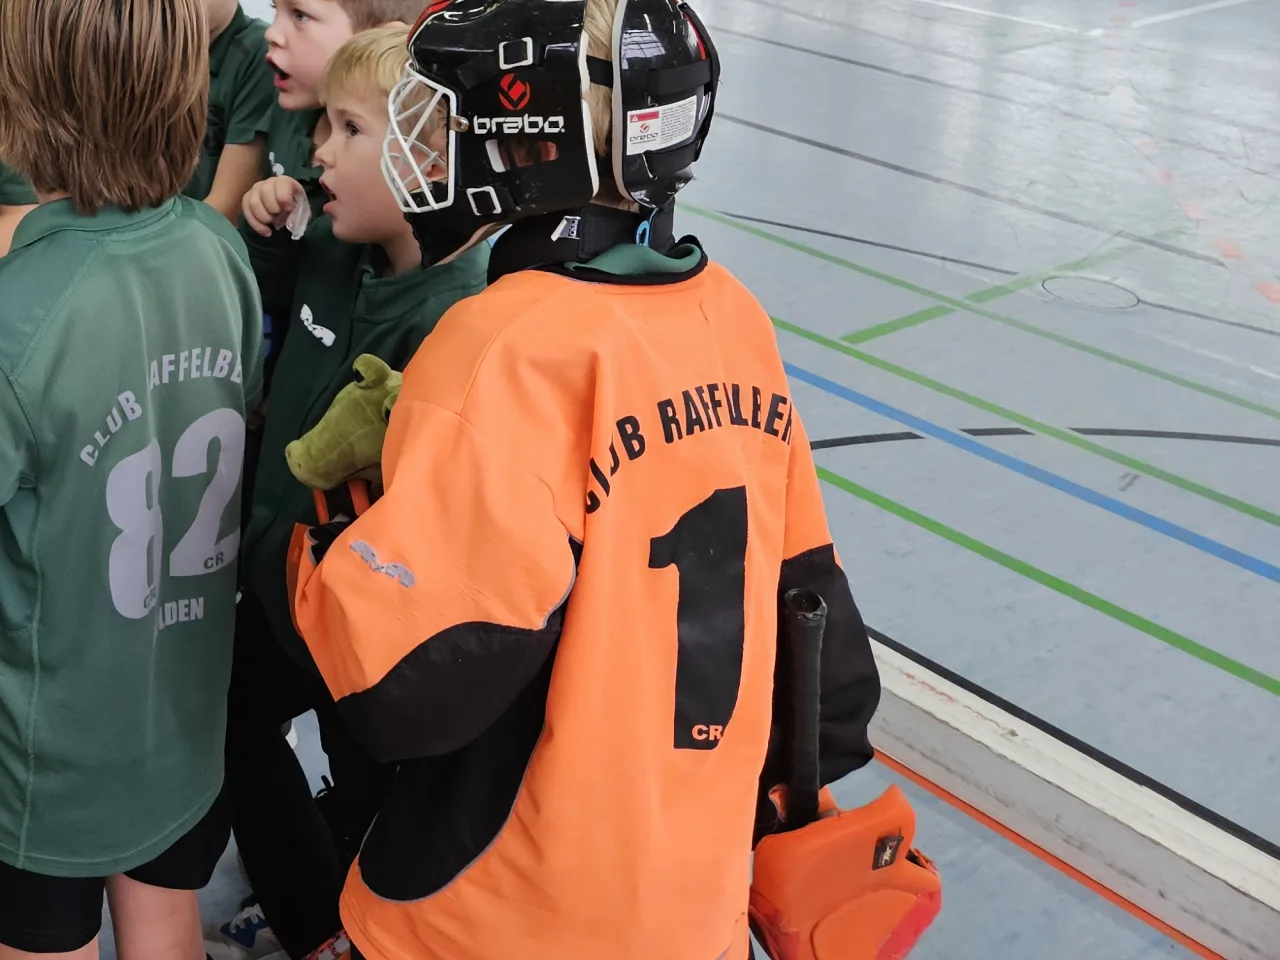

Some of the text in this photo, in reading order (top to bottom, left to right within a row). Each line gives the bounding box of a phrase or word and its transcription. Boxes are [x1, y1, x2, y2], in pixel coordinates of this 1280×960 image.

[473, 113, 565, 135] brabo
[79, 346, 242, 468] CLUB AFFELB
[105, 407, 246, 620] 82
[202, 550, 225, 570] CR
[648, 484, 749, 751] 1
[690, 723, 724, 741] CR
